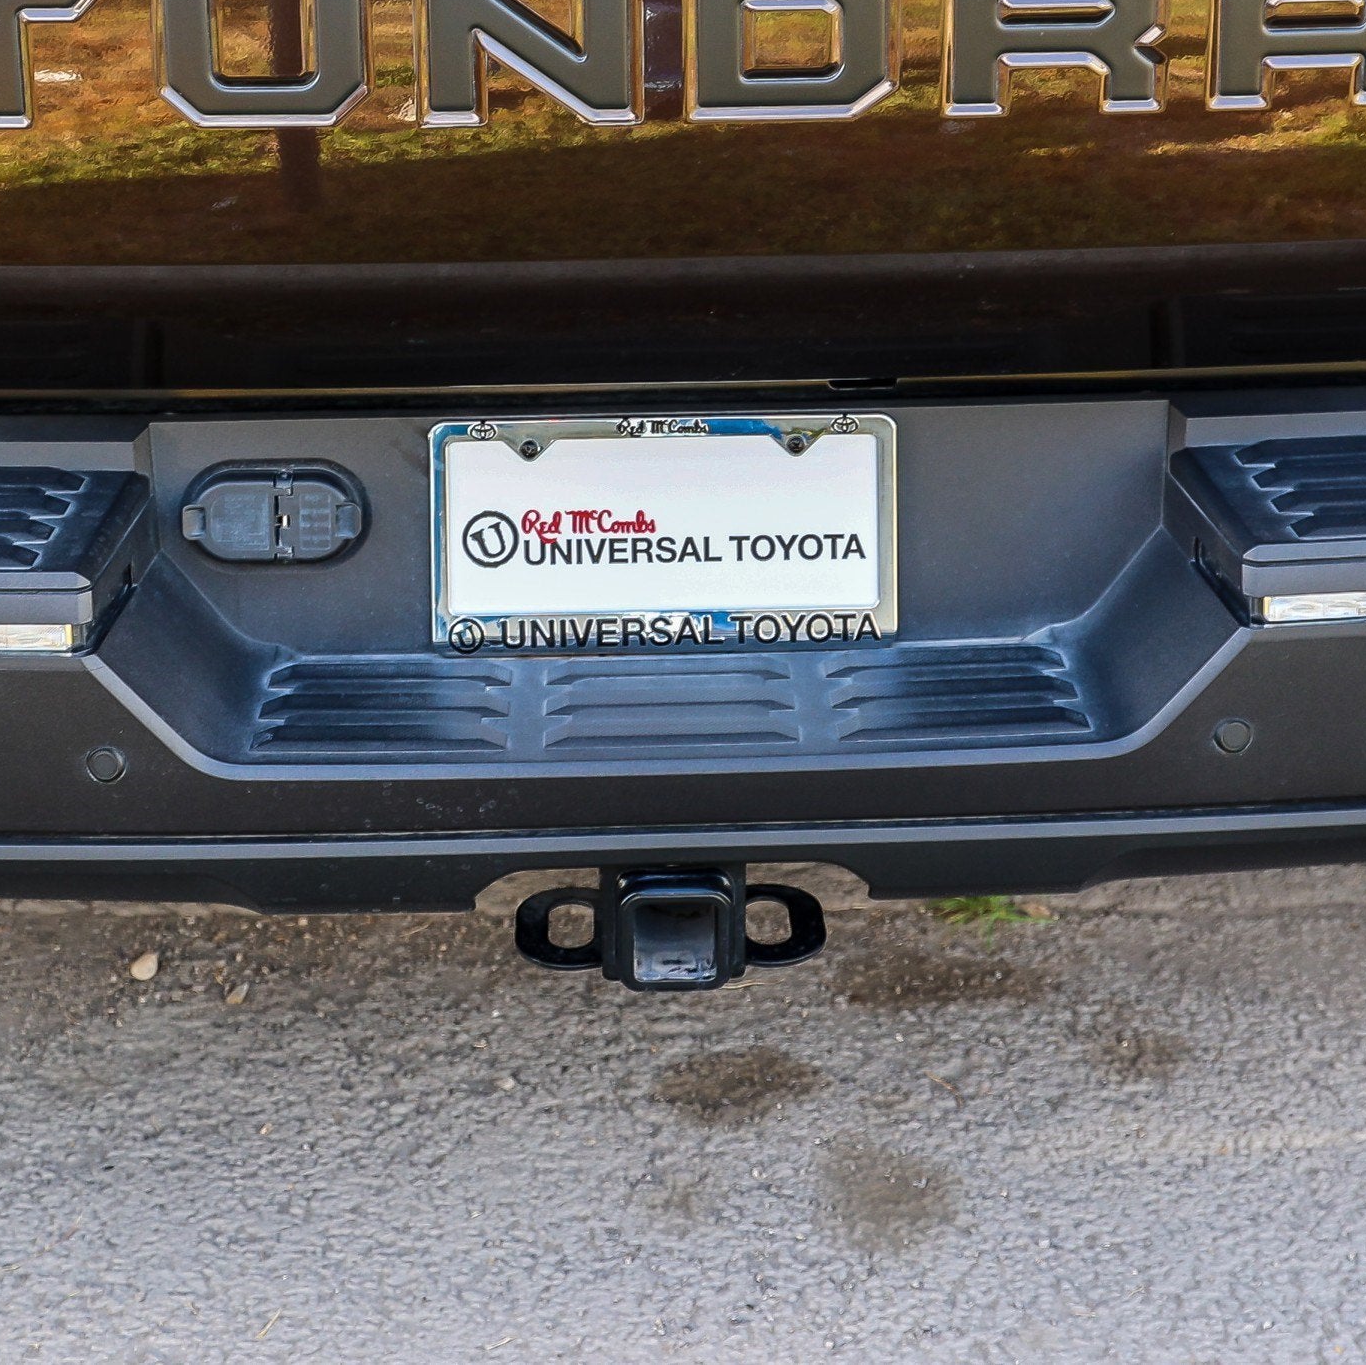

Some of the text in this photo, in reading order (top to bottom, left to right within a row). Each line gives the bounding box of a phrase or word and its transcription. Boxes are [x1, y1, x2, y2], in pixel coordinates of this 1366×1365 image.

[521, 509, 657, 544] Red McCombs
[523, 536, 723, 566] UNIVERSAL
[728, 533, 867, 562] TOYOTA
[498, 616, 726, 650] UNIVERSAL
[728, 612, 883, 645] TOYOTA
